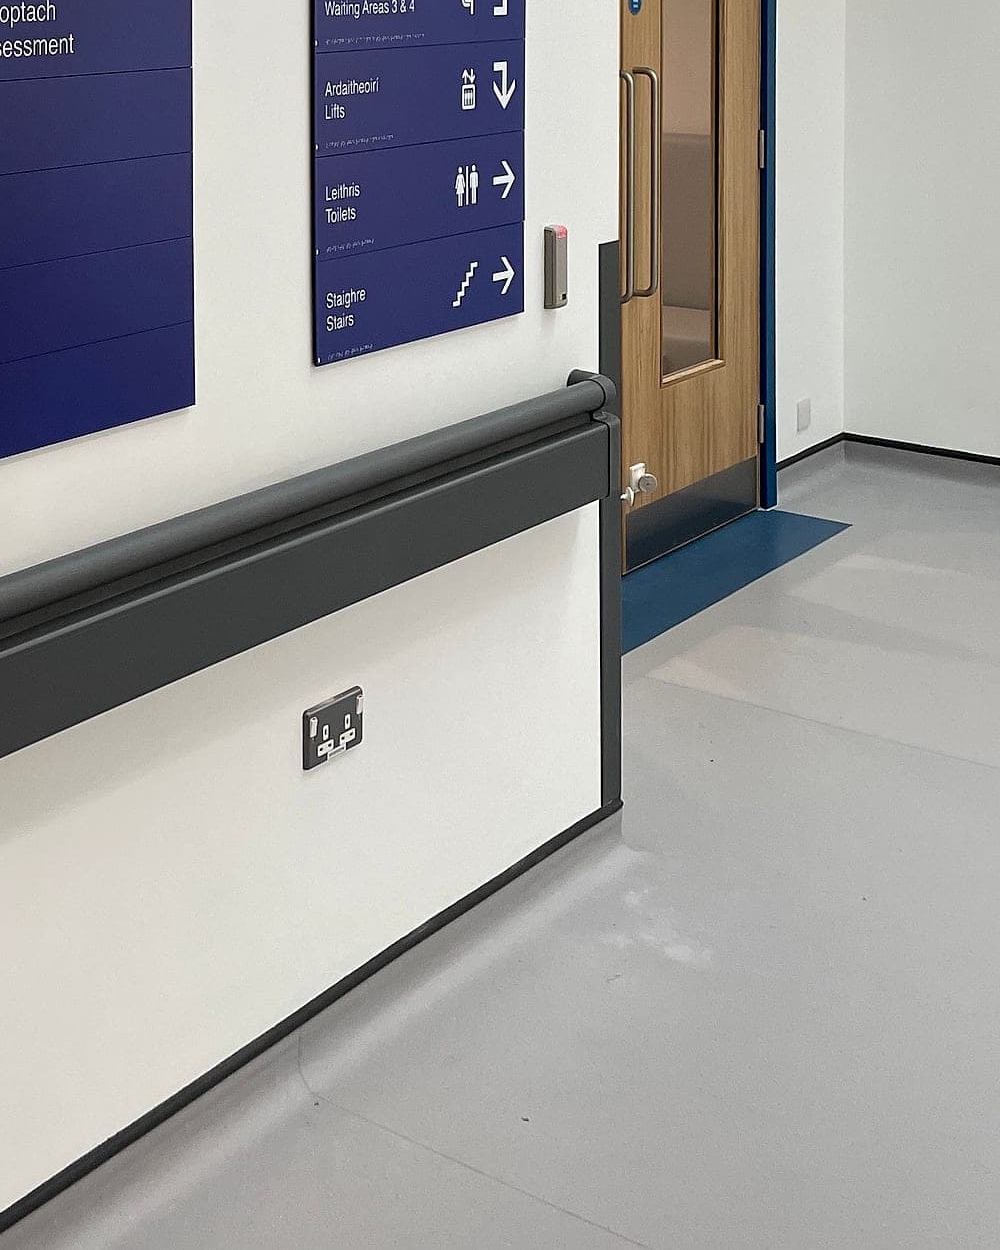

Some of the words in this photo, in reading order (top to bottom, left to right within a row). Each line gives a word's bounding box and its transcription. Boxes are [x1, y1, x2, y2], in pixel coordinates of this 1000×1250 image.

[324, 0, 361, 19] Waiting
[361, 0, 390, 15] Areas
[325, 103, 346, 120] Lifts
[325, 181, 361, 202] Leithris
[324, 206, 357, 224] Toilets
[326, 287, 366, 309] Staighre
[326, 314, 355, 332] Stairs
